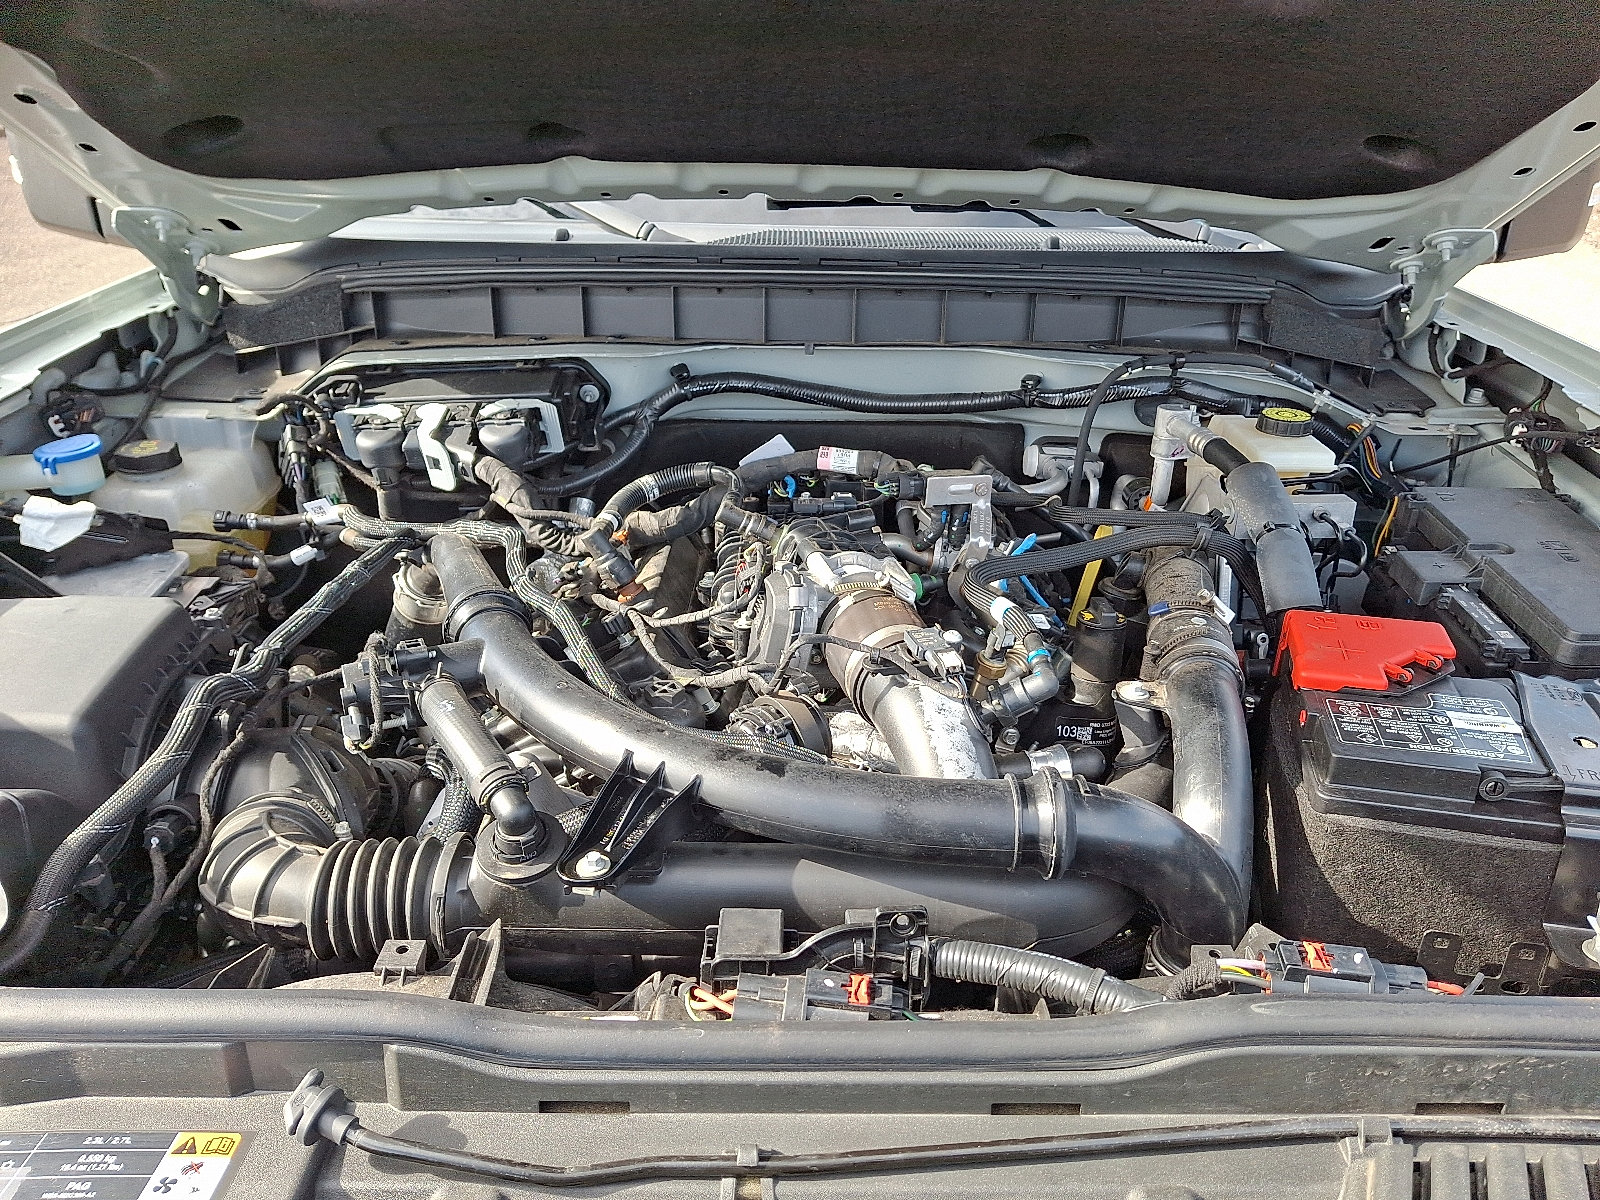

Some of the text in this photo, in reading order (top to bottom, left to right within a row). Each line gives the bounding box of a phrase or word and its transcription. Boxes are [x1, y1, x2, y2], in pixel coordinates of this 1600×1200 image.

[1056, 725, 1077, 738] 103
[1577, 768, 1600, 781] FR
[65, 1181, 92, 1191] PAG
